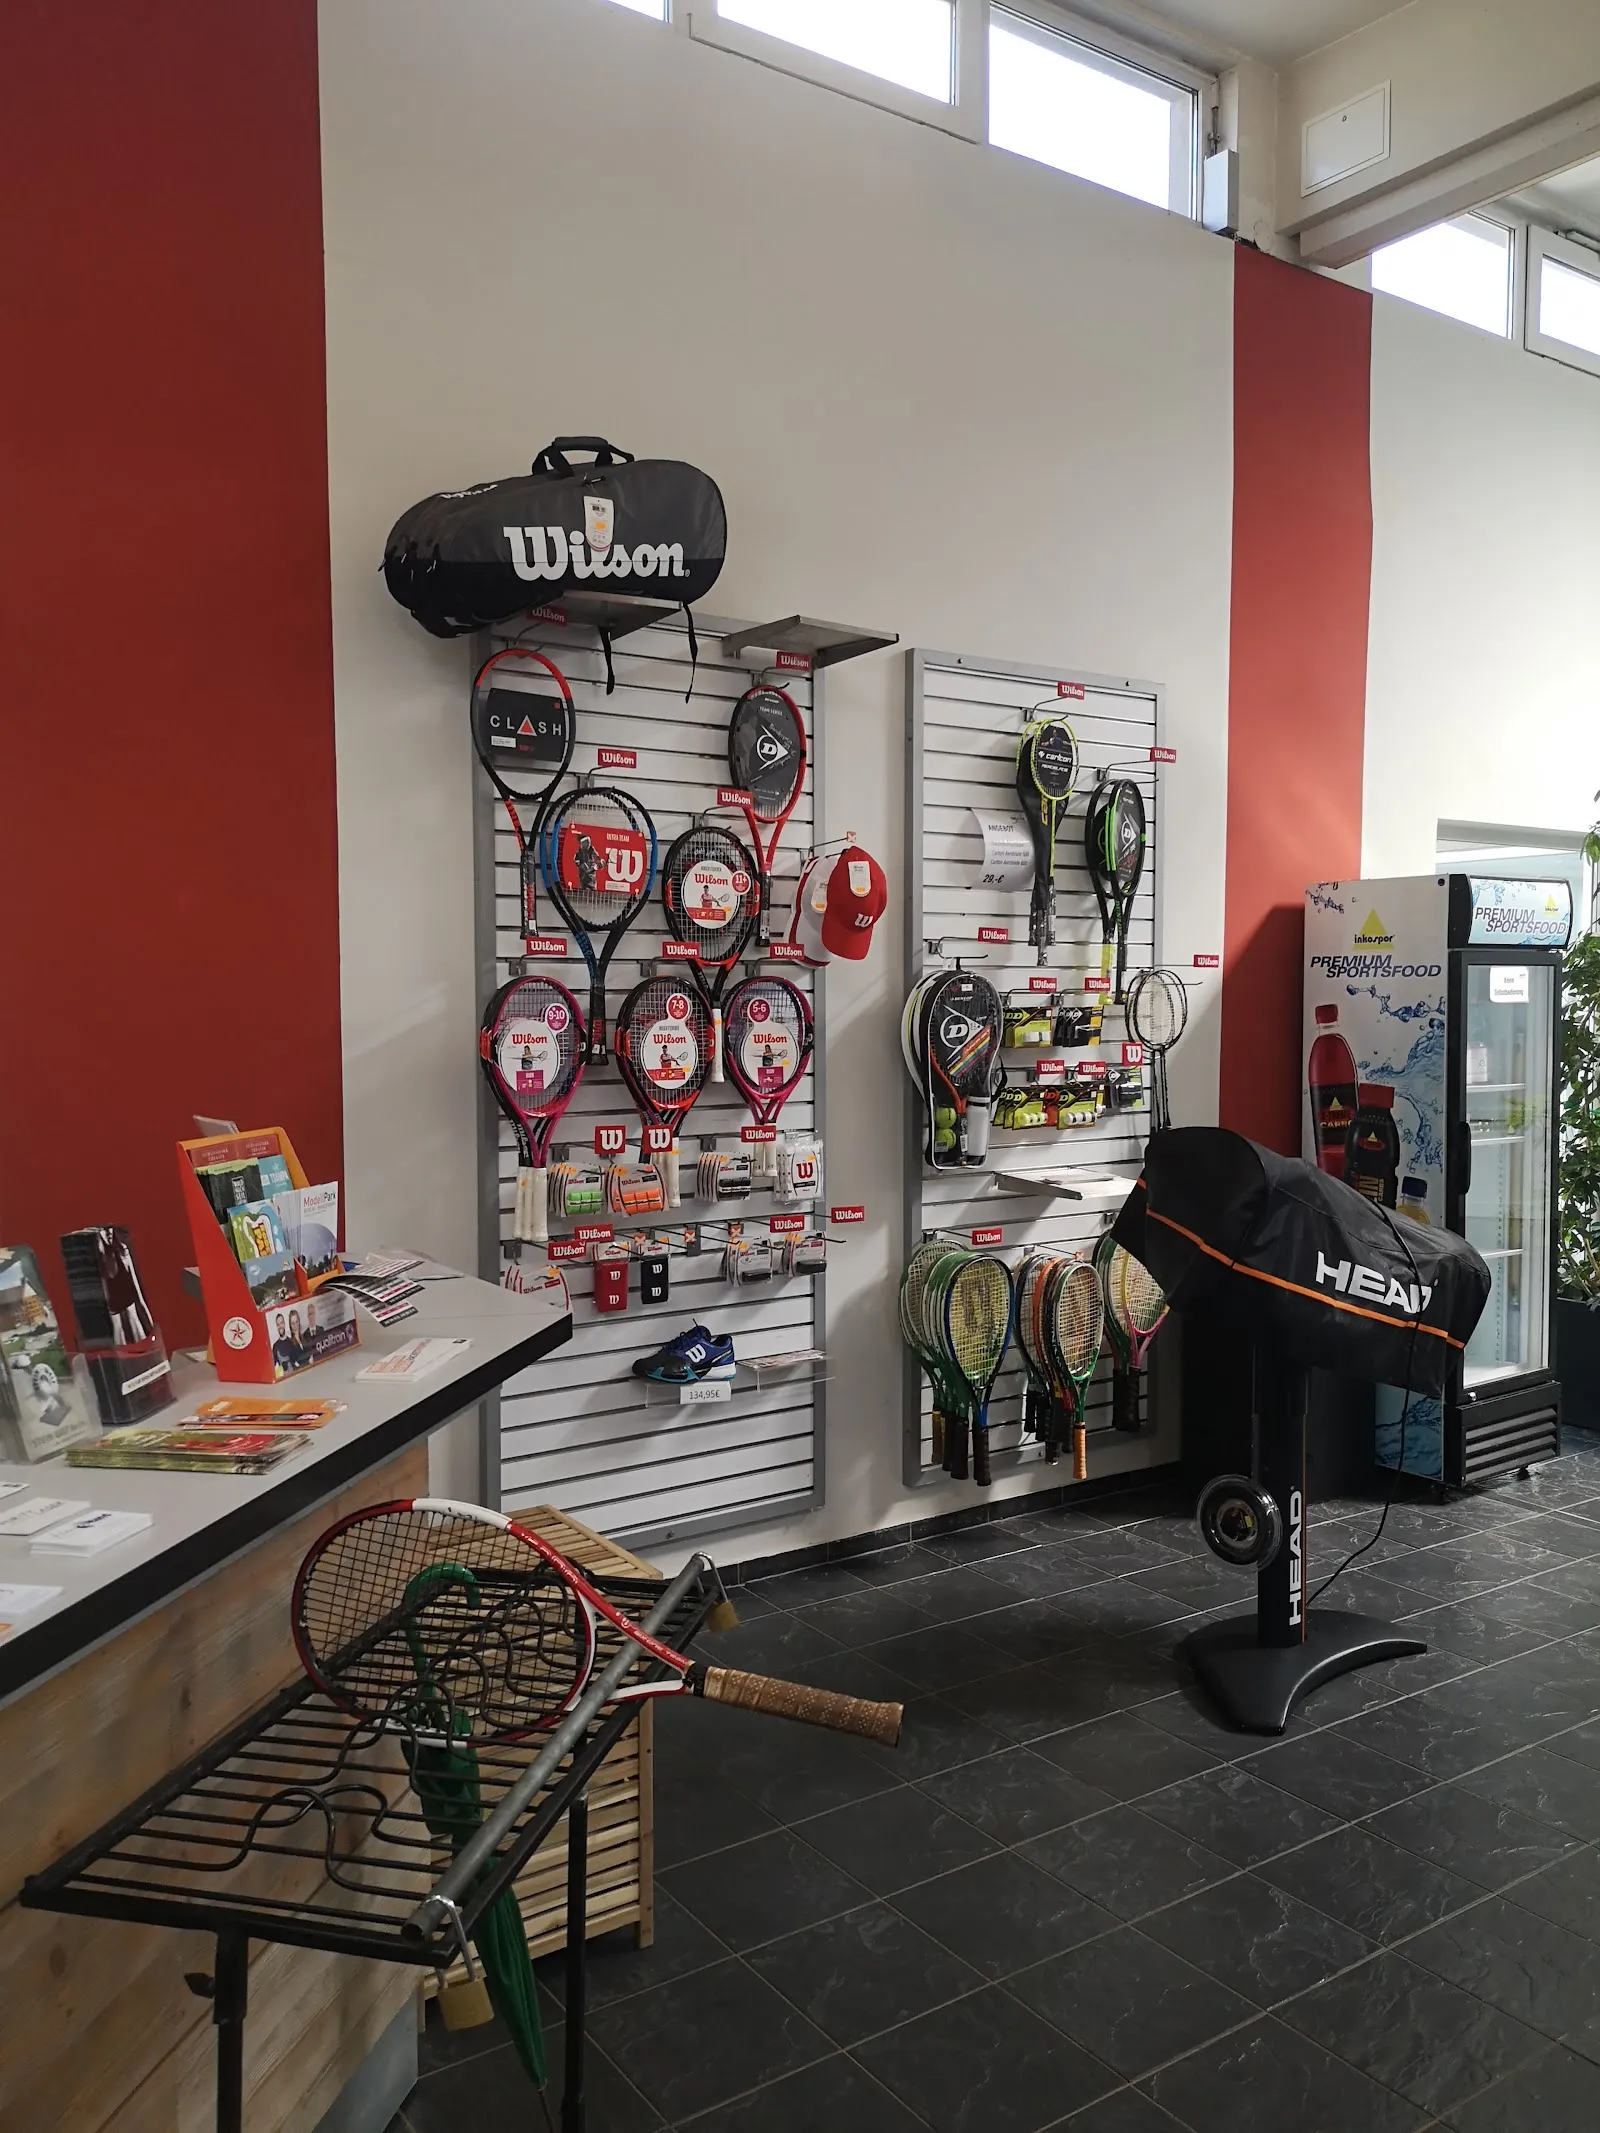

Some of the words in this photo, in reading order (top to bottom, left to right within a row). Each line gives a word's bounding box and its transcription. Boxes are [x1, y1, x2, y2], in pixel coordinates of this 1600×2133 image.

[531, 605, 566, 623] Wilson
[780, 655, 810, 668] Wilson
[1061, 685, 1084, 697] Wilson
[601, 751, 635, 766] Wilson
[1154, 750, 1175, 761] Wilson
[720, 792, 751, 805] Wilson
[605, 847, 643, 883] W
[694, 873, 729, 886] Wilson
[854, 912, 874, 928] W
[1474, 907, 1536, 921] PREMIUM
[1485, 920, 1567, 935] SPORTSFOOD
[982, 929, 1007, 941] Wilson
[1354, 934, 1393, 945] inkospor
[530, 940, 565, 952] Wilson
[666, 944, 698, 956] Wilson
[774, 946, 803, 957] Wilson
[1197, 957, 1219, 966] Wilson
[1310, 955, 1392, 968] PREMIUM
[1326, 964, 1442, 978] SPORTSFOOD
[1033, 979, 1057, 989] Wilson
[1088, 980, 1110, 989] Wilson
[671, 1000, 685, 1009] 7-8
[752, 1003, 767, 1013] 5-6
[548, 1009, 565, 1020] 9-10
[512, 1033, 548, 1045] Wilson
[652, 1033, 687, 1044] Wilson
[753, 1033, 788, 1044] Wilson
[1125, 1045, 1142, 1063] W
[1041, 1063, 1064, 1073] Wilson
[1082, 1064, 1105, 1073] Wilson
[600, 1129, 623, 1151] W
[648, 1128, 671, 1150] W
[745, 1129, 775, 1140] Wilson
[796, 1162, 814, 1179] W
[835, 1210, 863, 1221] Wilson
[774, 1219, 803, 1230] Wilson
[578, 1228, 611, 1240] Wilson
[976, 1232, 1001, 1244] Wilson
[552, 1245, 585, 1257] Wilson
[652, 1263, 663, 1274] W
[609, 1270, 621, 1281] W
[651, 1286, 662, 1297] W
[608, 1294, 620, 1305] W
[685, 1343, 706, 1363] W
[689, 1389, 720, 1400] 134,95€
[1288, 1490, 1302, 1626] HEAD
